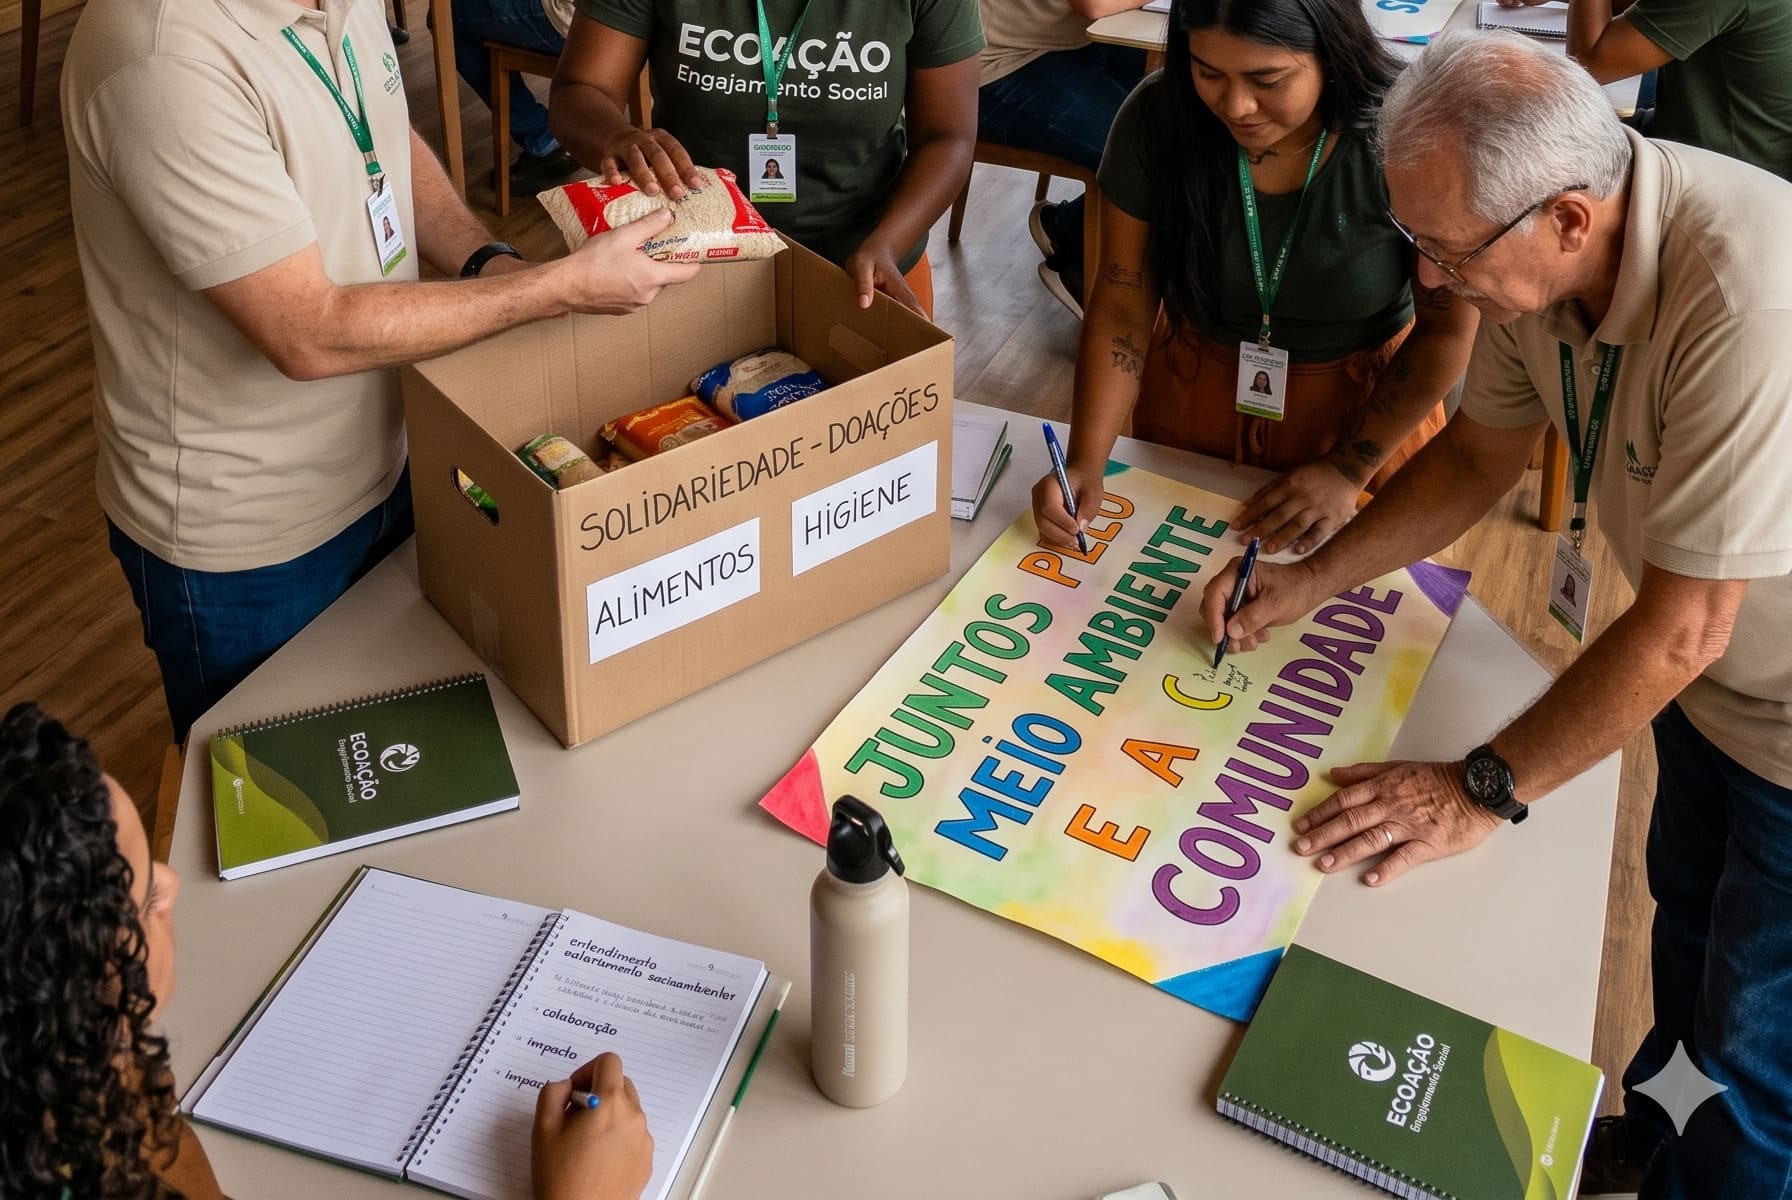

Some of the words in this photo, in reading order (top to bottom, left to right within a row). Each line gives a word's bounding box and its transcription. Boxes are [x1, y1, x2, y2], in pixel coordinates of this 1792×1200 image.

[678, 22, 891, 80] ECOAÇÃO
[828, 81, 888, 100] Social
[828, 382, 940, 455] DOAÇÕES
[1043, 505, 1231, 717] AMBIENTE
[843, 592, 1054, 799] JUNTOS
[350, 732, 380, 801] ECOAÇÃO
[1151, 584, 1405, 927] COMUNIDADE
[1064, 803, 1152, 862] E
[1120, 738, 1201, 788] A
[527, 1037, 578, 1060] impacto
[542, 1004, 618, 1036] colaboração
[505, 1070, 551, 1090] impac
[1386, 1033, 1435, 1128] ECOAÇÃO
